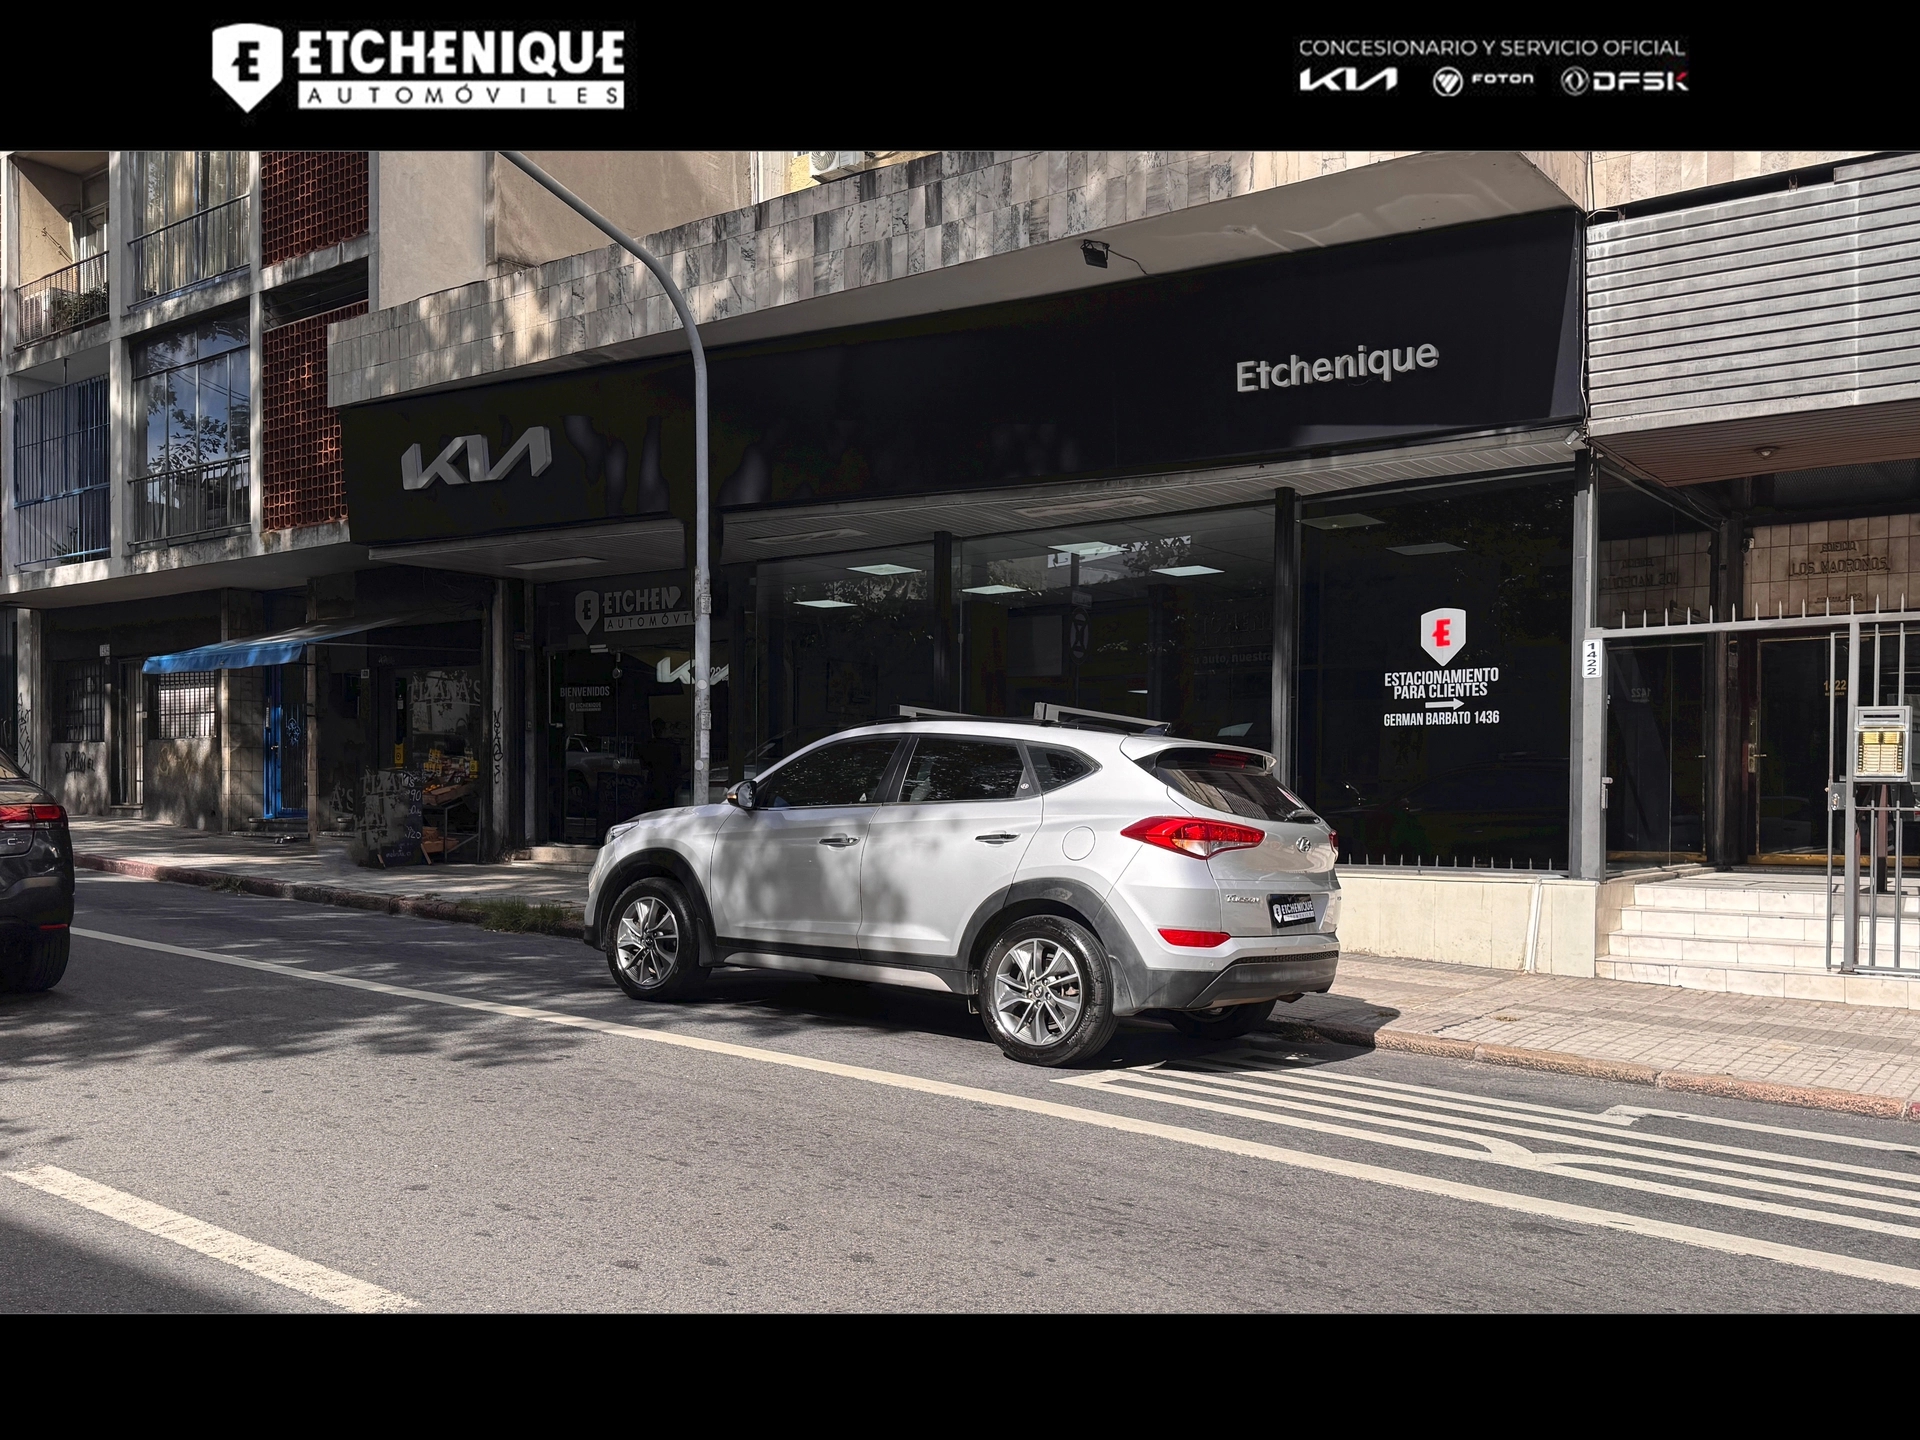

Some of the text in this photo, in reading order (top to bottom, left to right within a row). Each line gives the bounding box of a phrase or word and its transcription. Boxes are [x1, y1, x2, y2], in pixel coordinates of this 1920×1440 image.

[1236, 343, 1440, 392] Etchenique
[401, 426, 553, 490] KIA
[1789, 554, 1890, 576] LOS MADROÑOS
[1586, 642, 1597, 676] 1422
[1384, 667, 1499, 687] ESTACIONAMIENTO
[1823, 680, 1847, 691] 122
[560, 686, 610, 698] BIENVENIDOS
[1394, 681, 1488, 699] PARA CLIENTES
[1383, 710, 1500, 727] GERMAN BARBATO 1436
[1281, 901, 1314, 914] ETCHENIQUE
